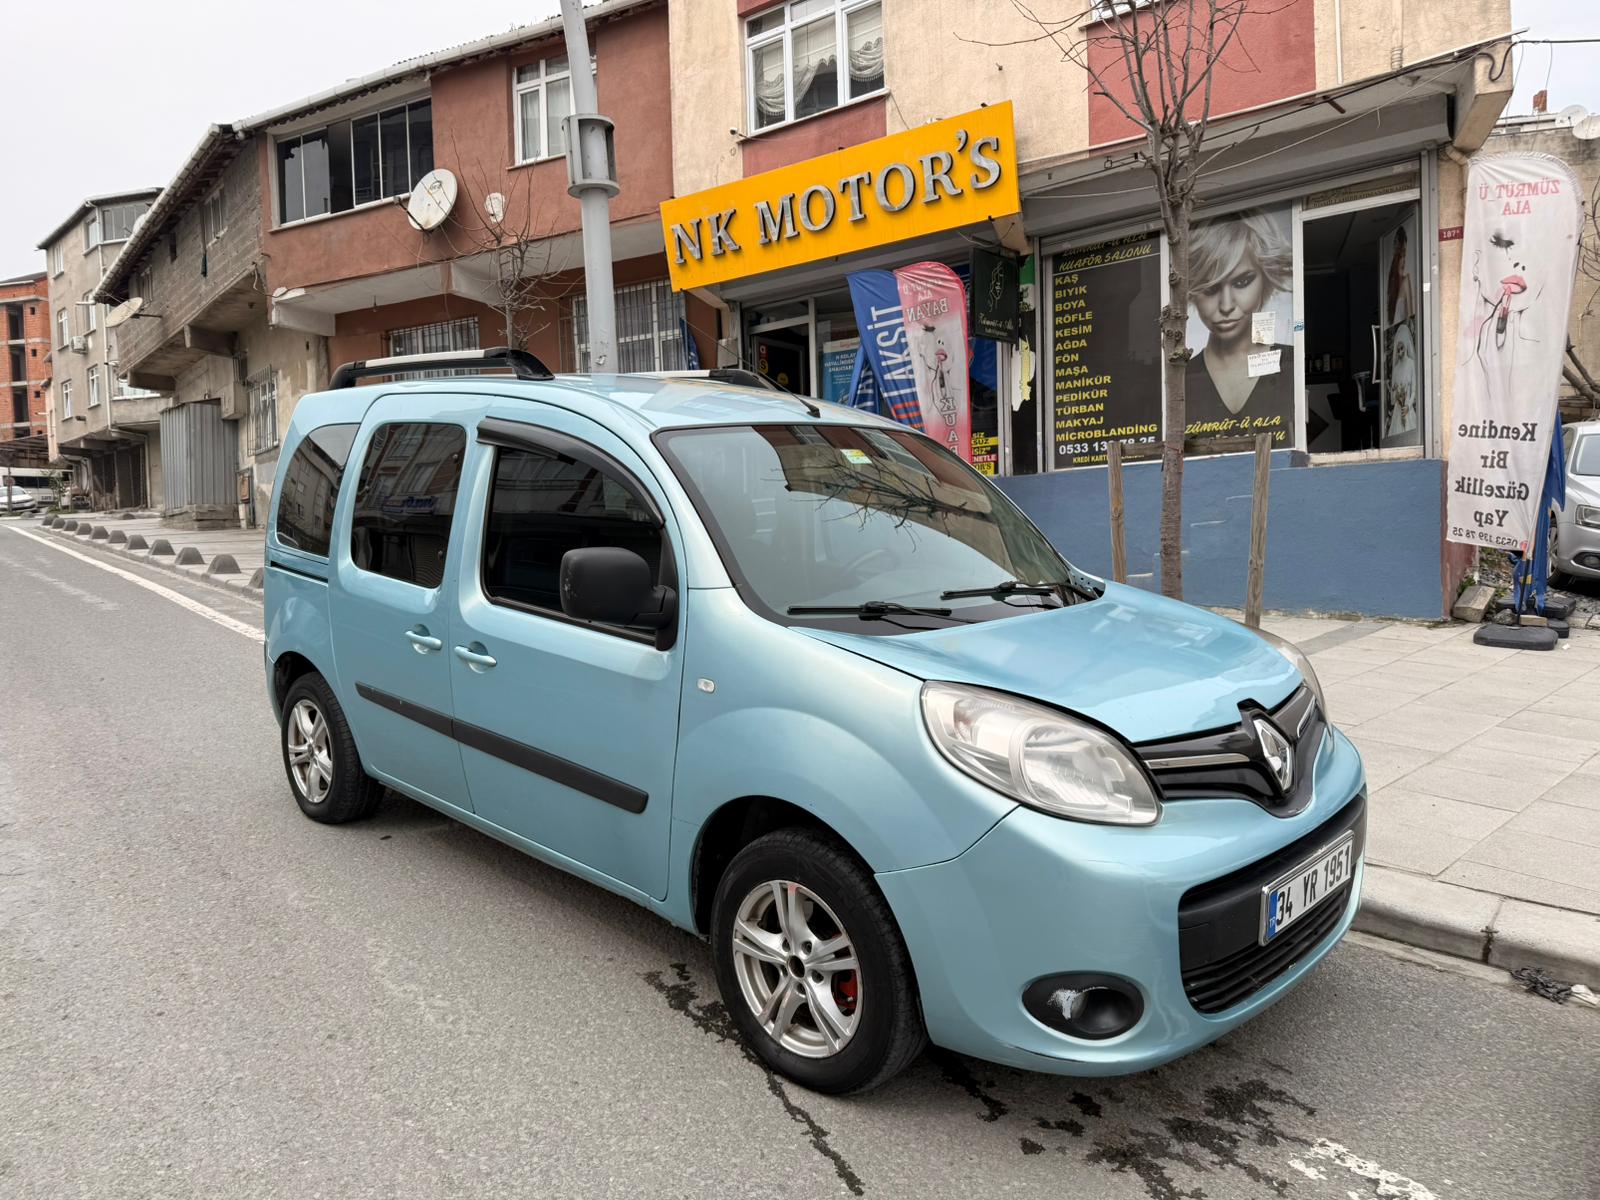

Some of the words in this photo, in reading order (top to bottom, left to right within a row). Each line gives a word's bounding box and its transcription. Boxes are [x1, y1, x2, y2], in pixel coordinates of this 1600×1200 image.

[670, 208, 742, 265] NK
[754, 129, 1002, 246] MOTOR'S
[1059, 254, 1103, 272] KUAFÖR
[1104, 244, 1152, 263] SALONU
[1055, 273, 1079, 285] KAŞ
[1055, 285, 1087, 298] BIYIK
[1055, 299, 1086, 312] BOYA
[1055, 311, 1093, 325] RÖFLE
[1055, 324, 1092, 338] KESİM
[1055, 338, 1088, 351] AĞDA
[1055, 353, 1079, 364] FÖN
[1055, 365, 1089, 377] MAŞA
[1055, 375, 1112, 390] MANİKÜR
[1055, 389, 1108, 403] PEDİKÜR
[1055, 403, 1104, 416] TÜRBAN
[1055, 416, 1104, 429] MAKYAJ
[1184, 416, 1250, 435] ZÜMRÜT-Ü
[1253, 415, 1281, 428] ALA
[1055, 423, 1158, 442] MİCROBLANDİNG
[1059, 443, 1088, 455] 0533
[1093, 440, 1114, 451] 13
[1276, 886, 1293, 926] 34
[1303, 869, 1318, 907] YR
[1324, 845, 1350, 891] 1951
